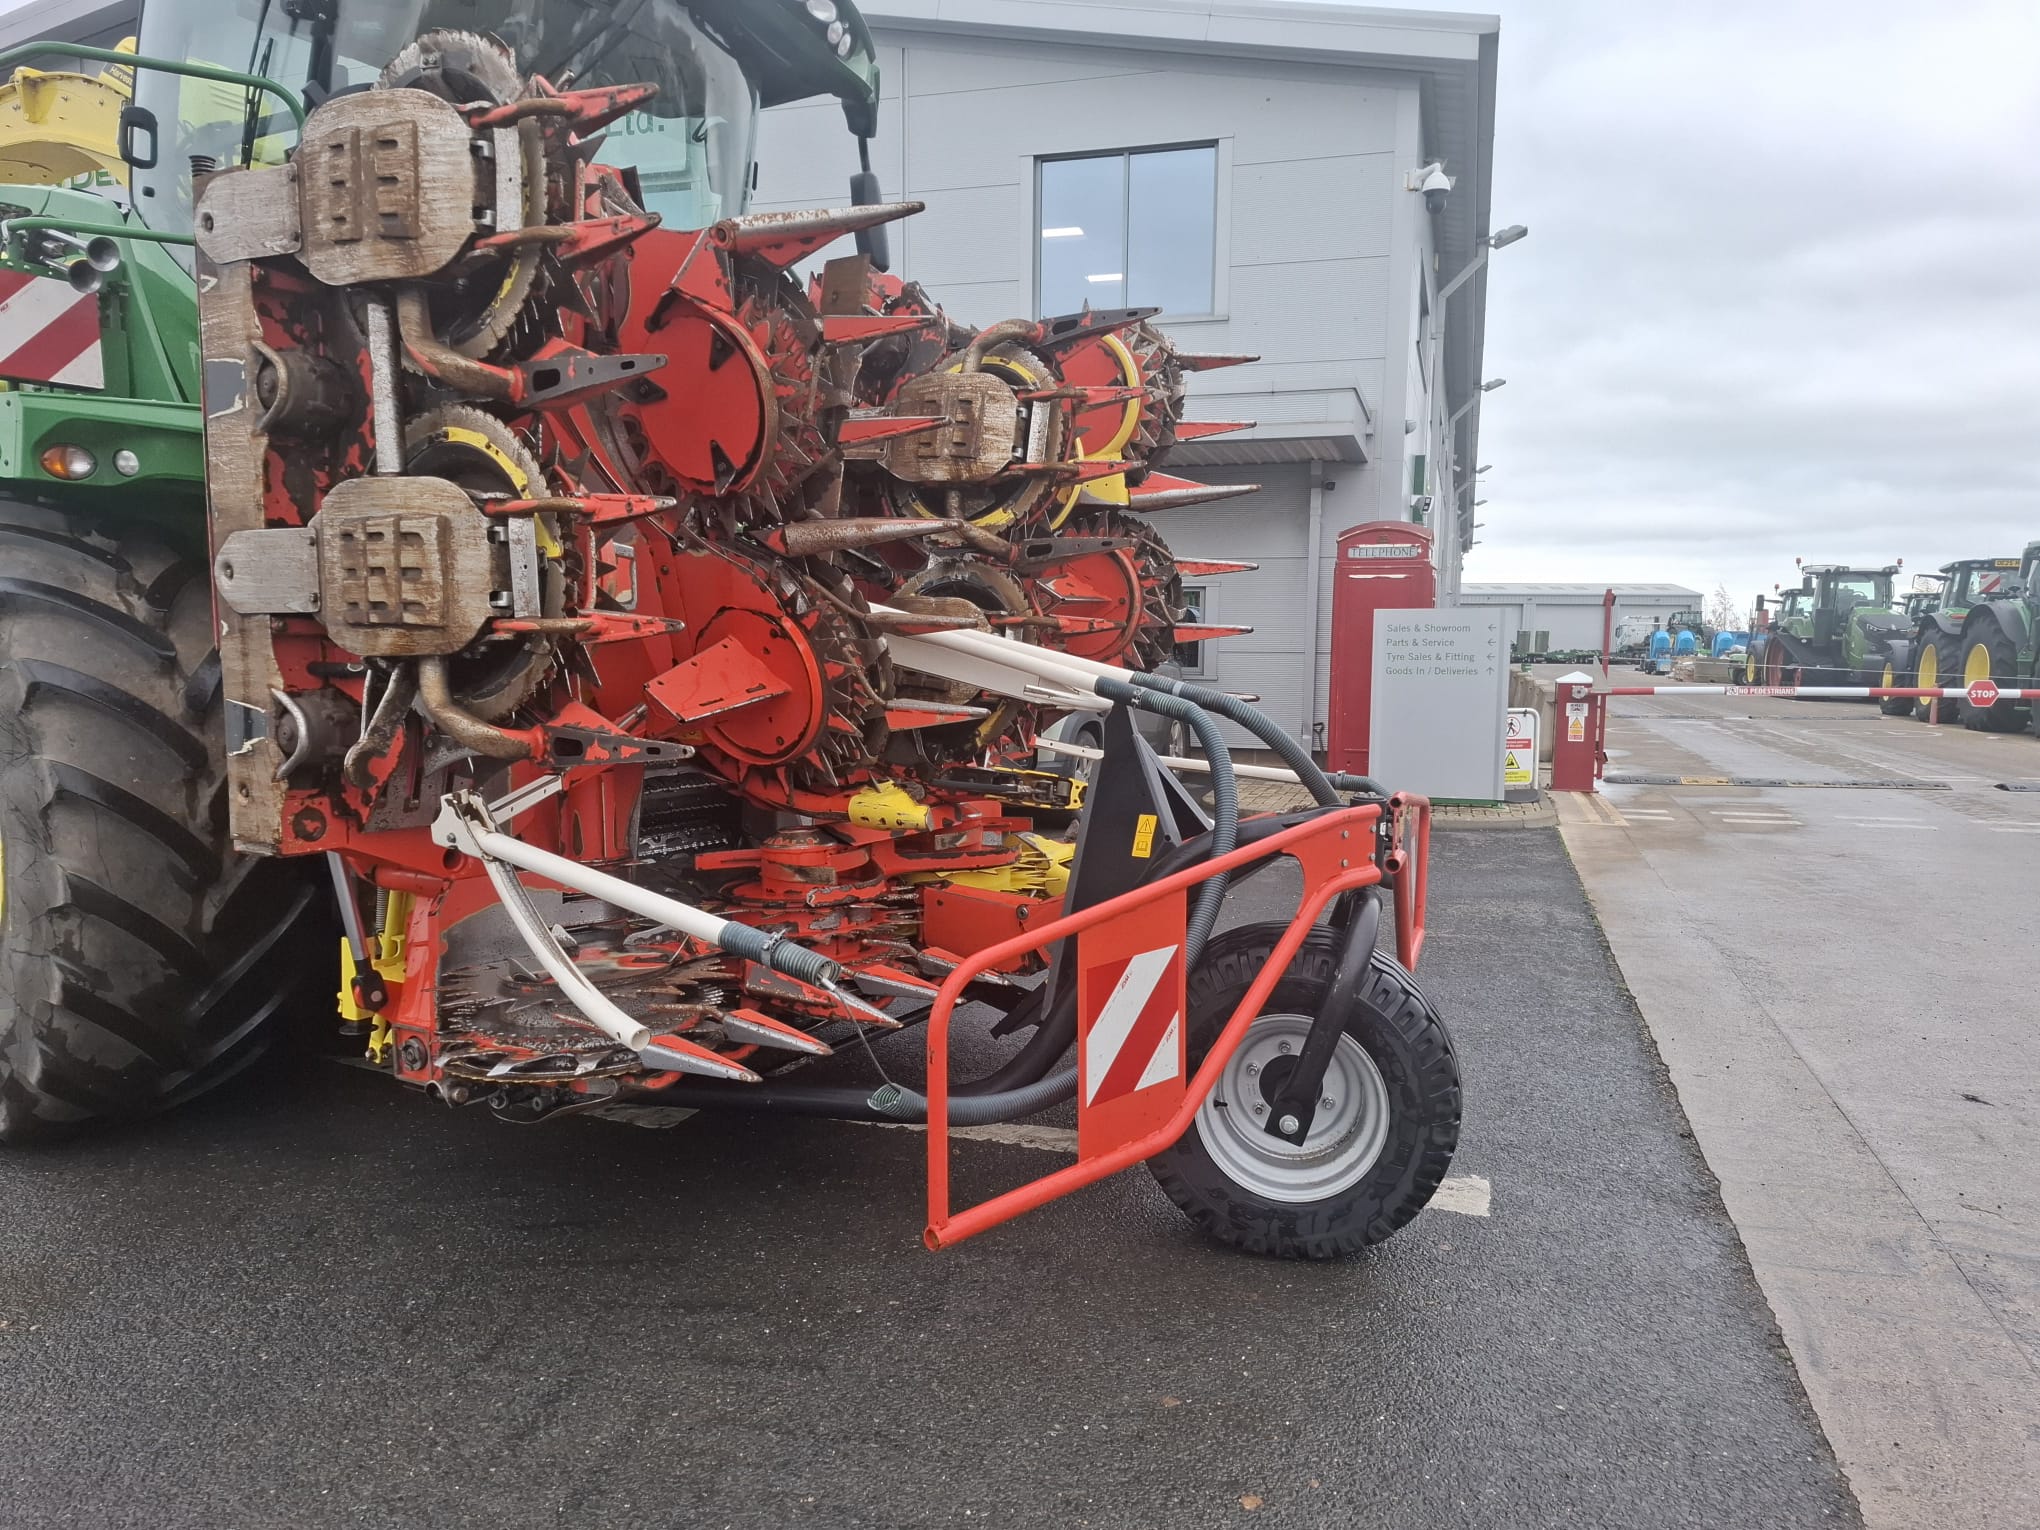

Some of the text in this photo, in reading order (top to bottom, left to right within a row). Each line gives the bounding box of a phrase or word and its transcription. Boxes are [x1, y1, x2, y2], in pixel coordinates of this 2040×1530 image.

[1352, 547, 1416, 557] TELEPHONE
[1386, 623, 1471, 633] Sales & Showroom
[1386, 638, 1455, 647] Parts & Service
[1386, 652, 1475, 663] Tyre Sales & Fitting
[1385, 666, 1413, 675] Goods
[1416, 666, 1425, 675] In
[1434, 666, 1478, 675] Deliveries
[1739, 687, 1795, 695] NO PEDESTRIANS
[1970, 690, 1996, 698] STOP
